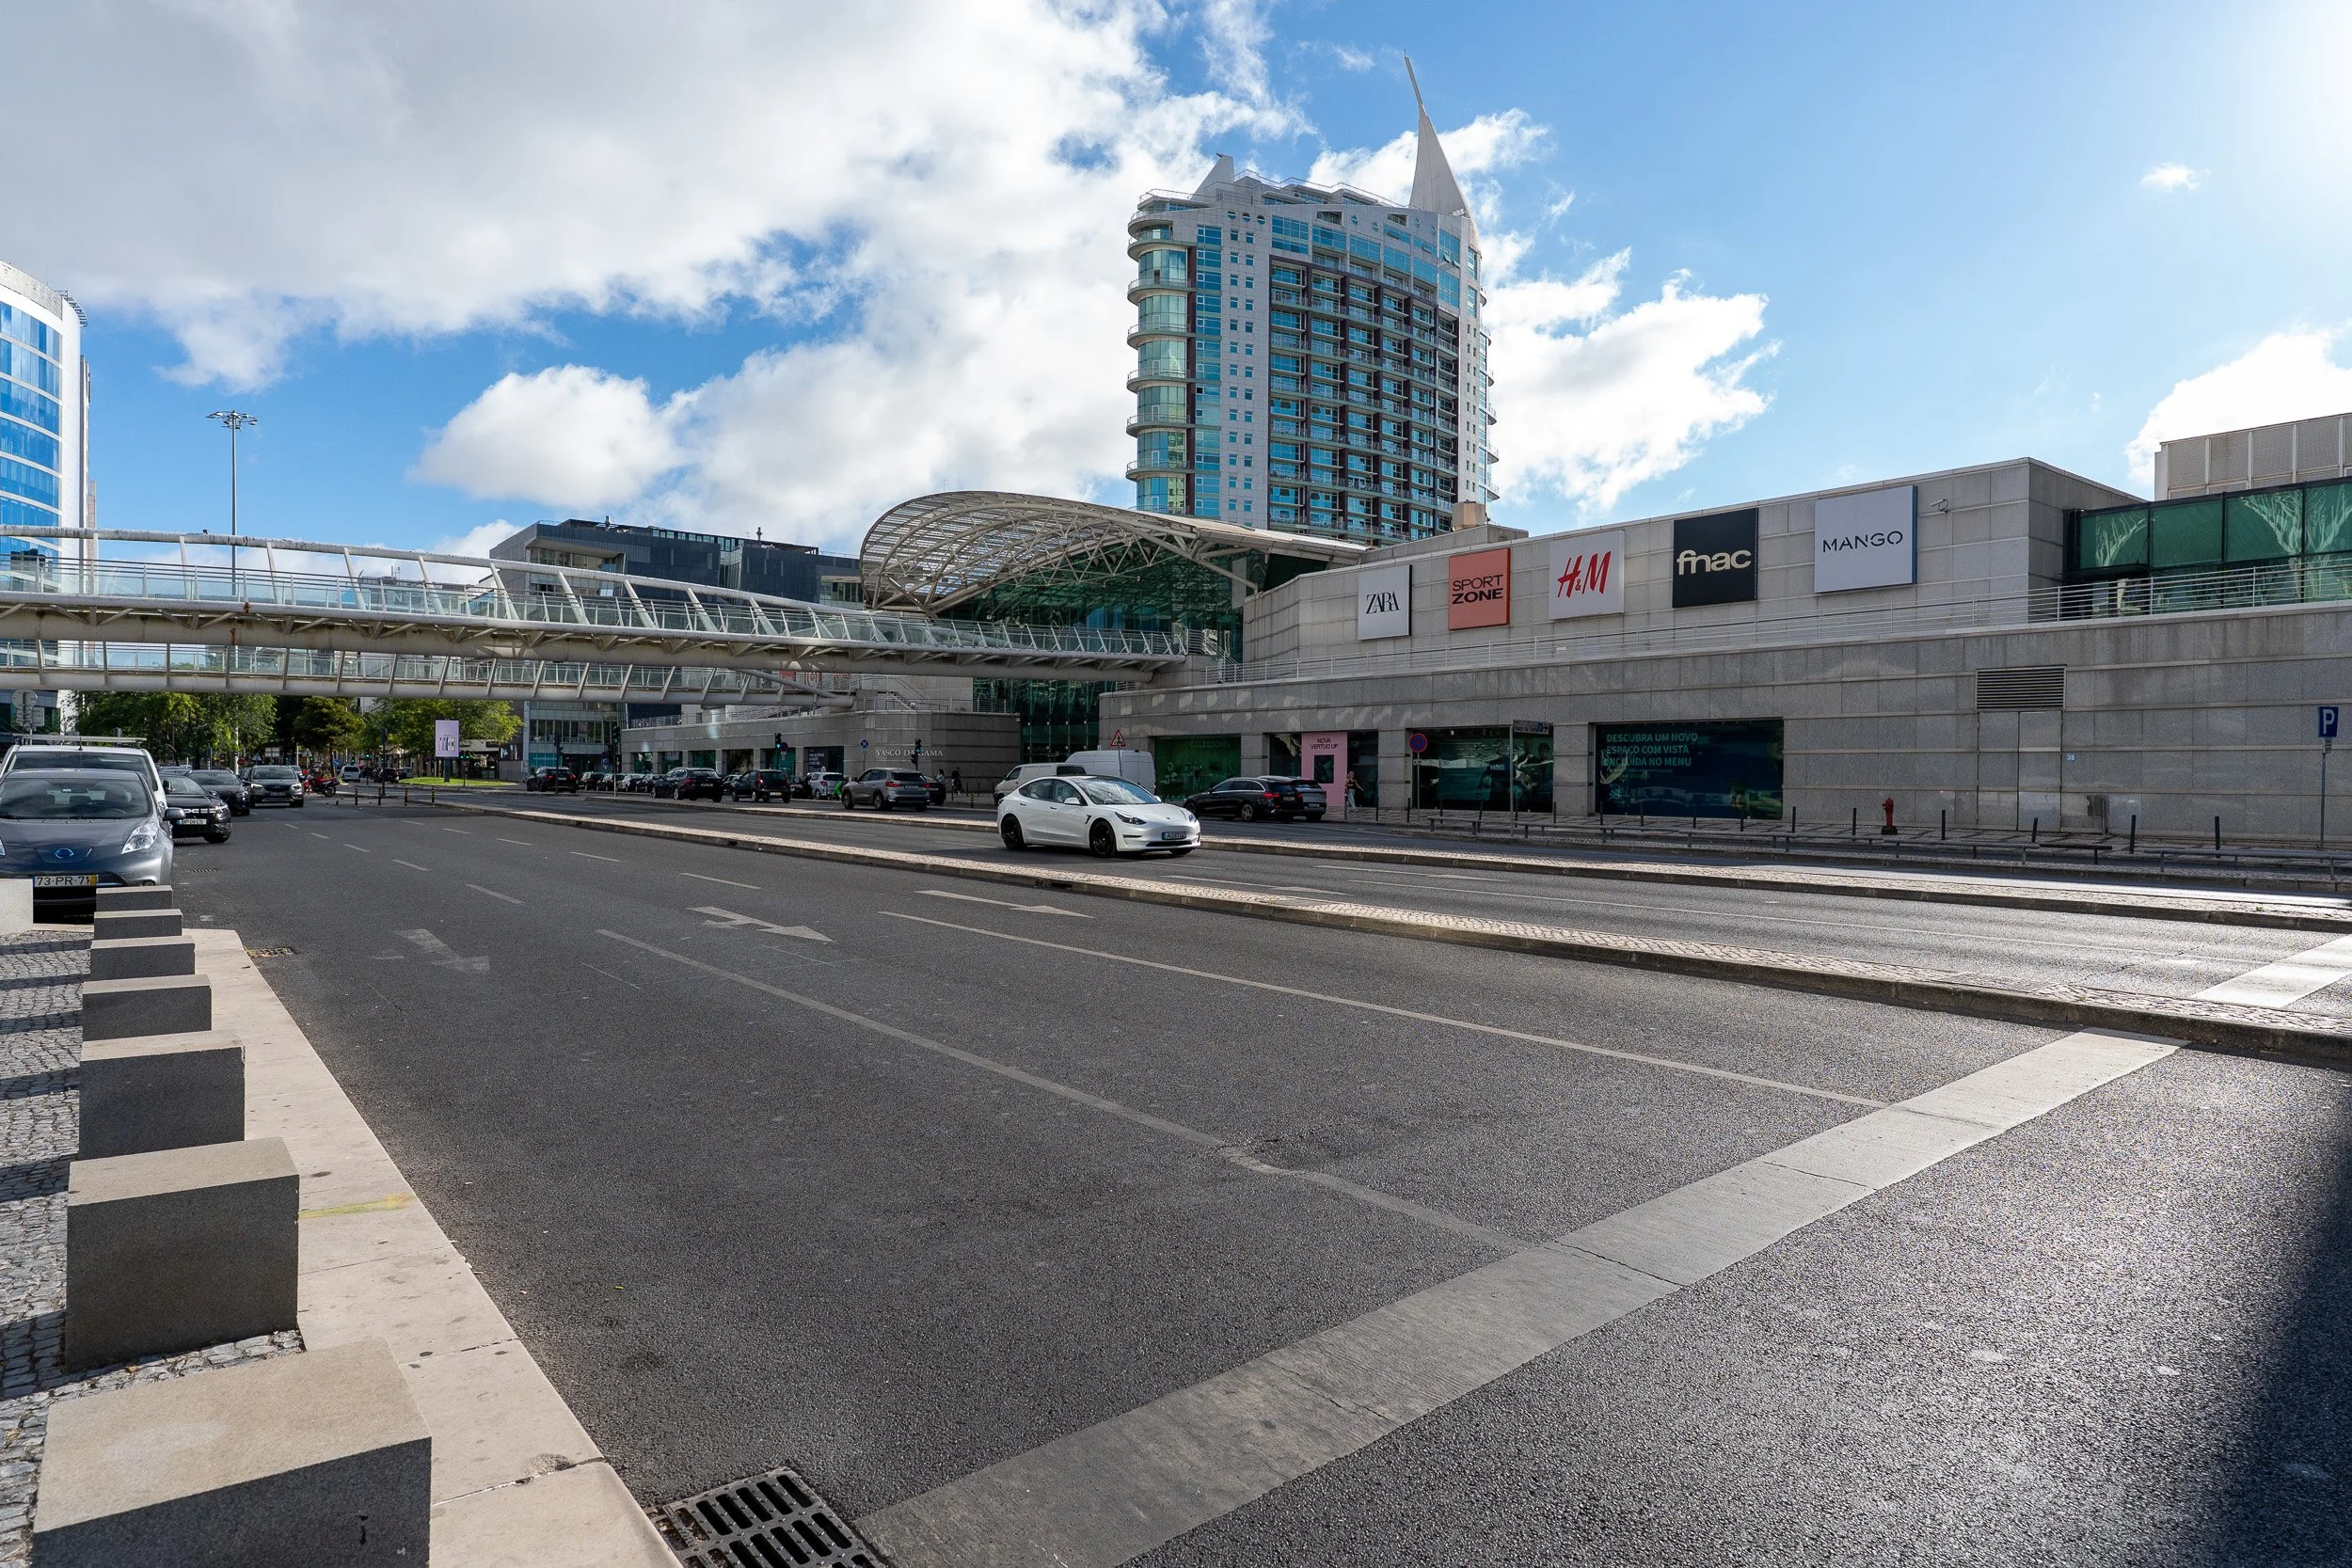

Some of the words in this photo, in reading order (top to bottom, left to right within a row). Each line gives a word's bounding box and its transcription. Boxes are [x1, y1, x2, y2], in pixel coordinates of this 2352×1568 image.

[1822, 531, 1903, 553] MANGO
[1677, 549, 1752, 576] fnac
[1452, 574, 1503, 592] SPORT
[1557, 550, 1612, 598] H&M
[1366, 591, 1401, 614] ZARA
[1452, 588, 1504, 605] ZONE
[2323, 708, 2335, 734] P
[1655, 733, 1669, 742] UM
[1671, 733, 1698, 742] NOVO
[1642, 745, 1661, 754] COM
[1663, 745, 1690, 754] VISTA
[1648, 757, 1662, 767] NO
[1664, 757, 1692, 767] MENU
